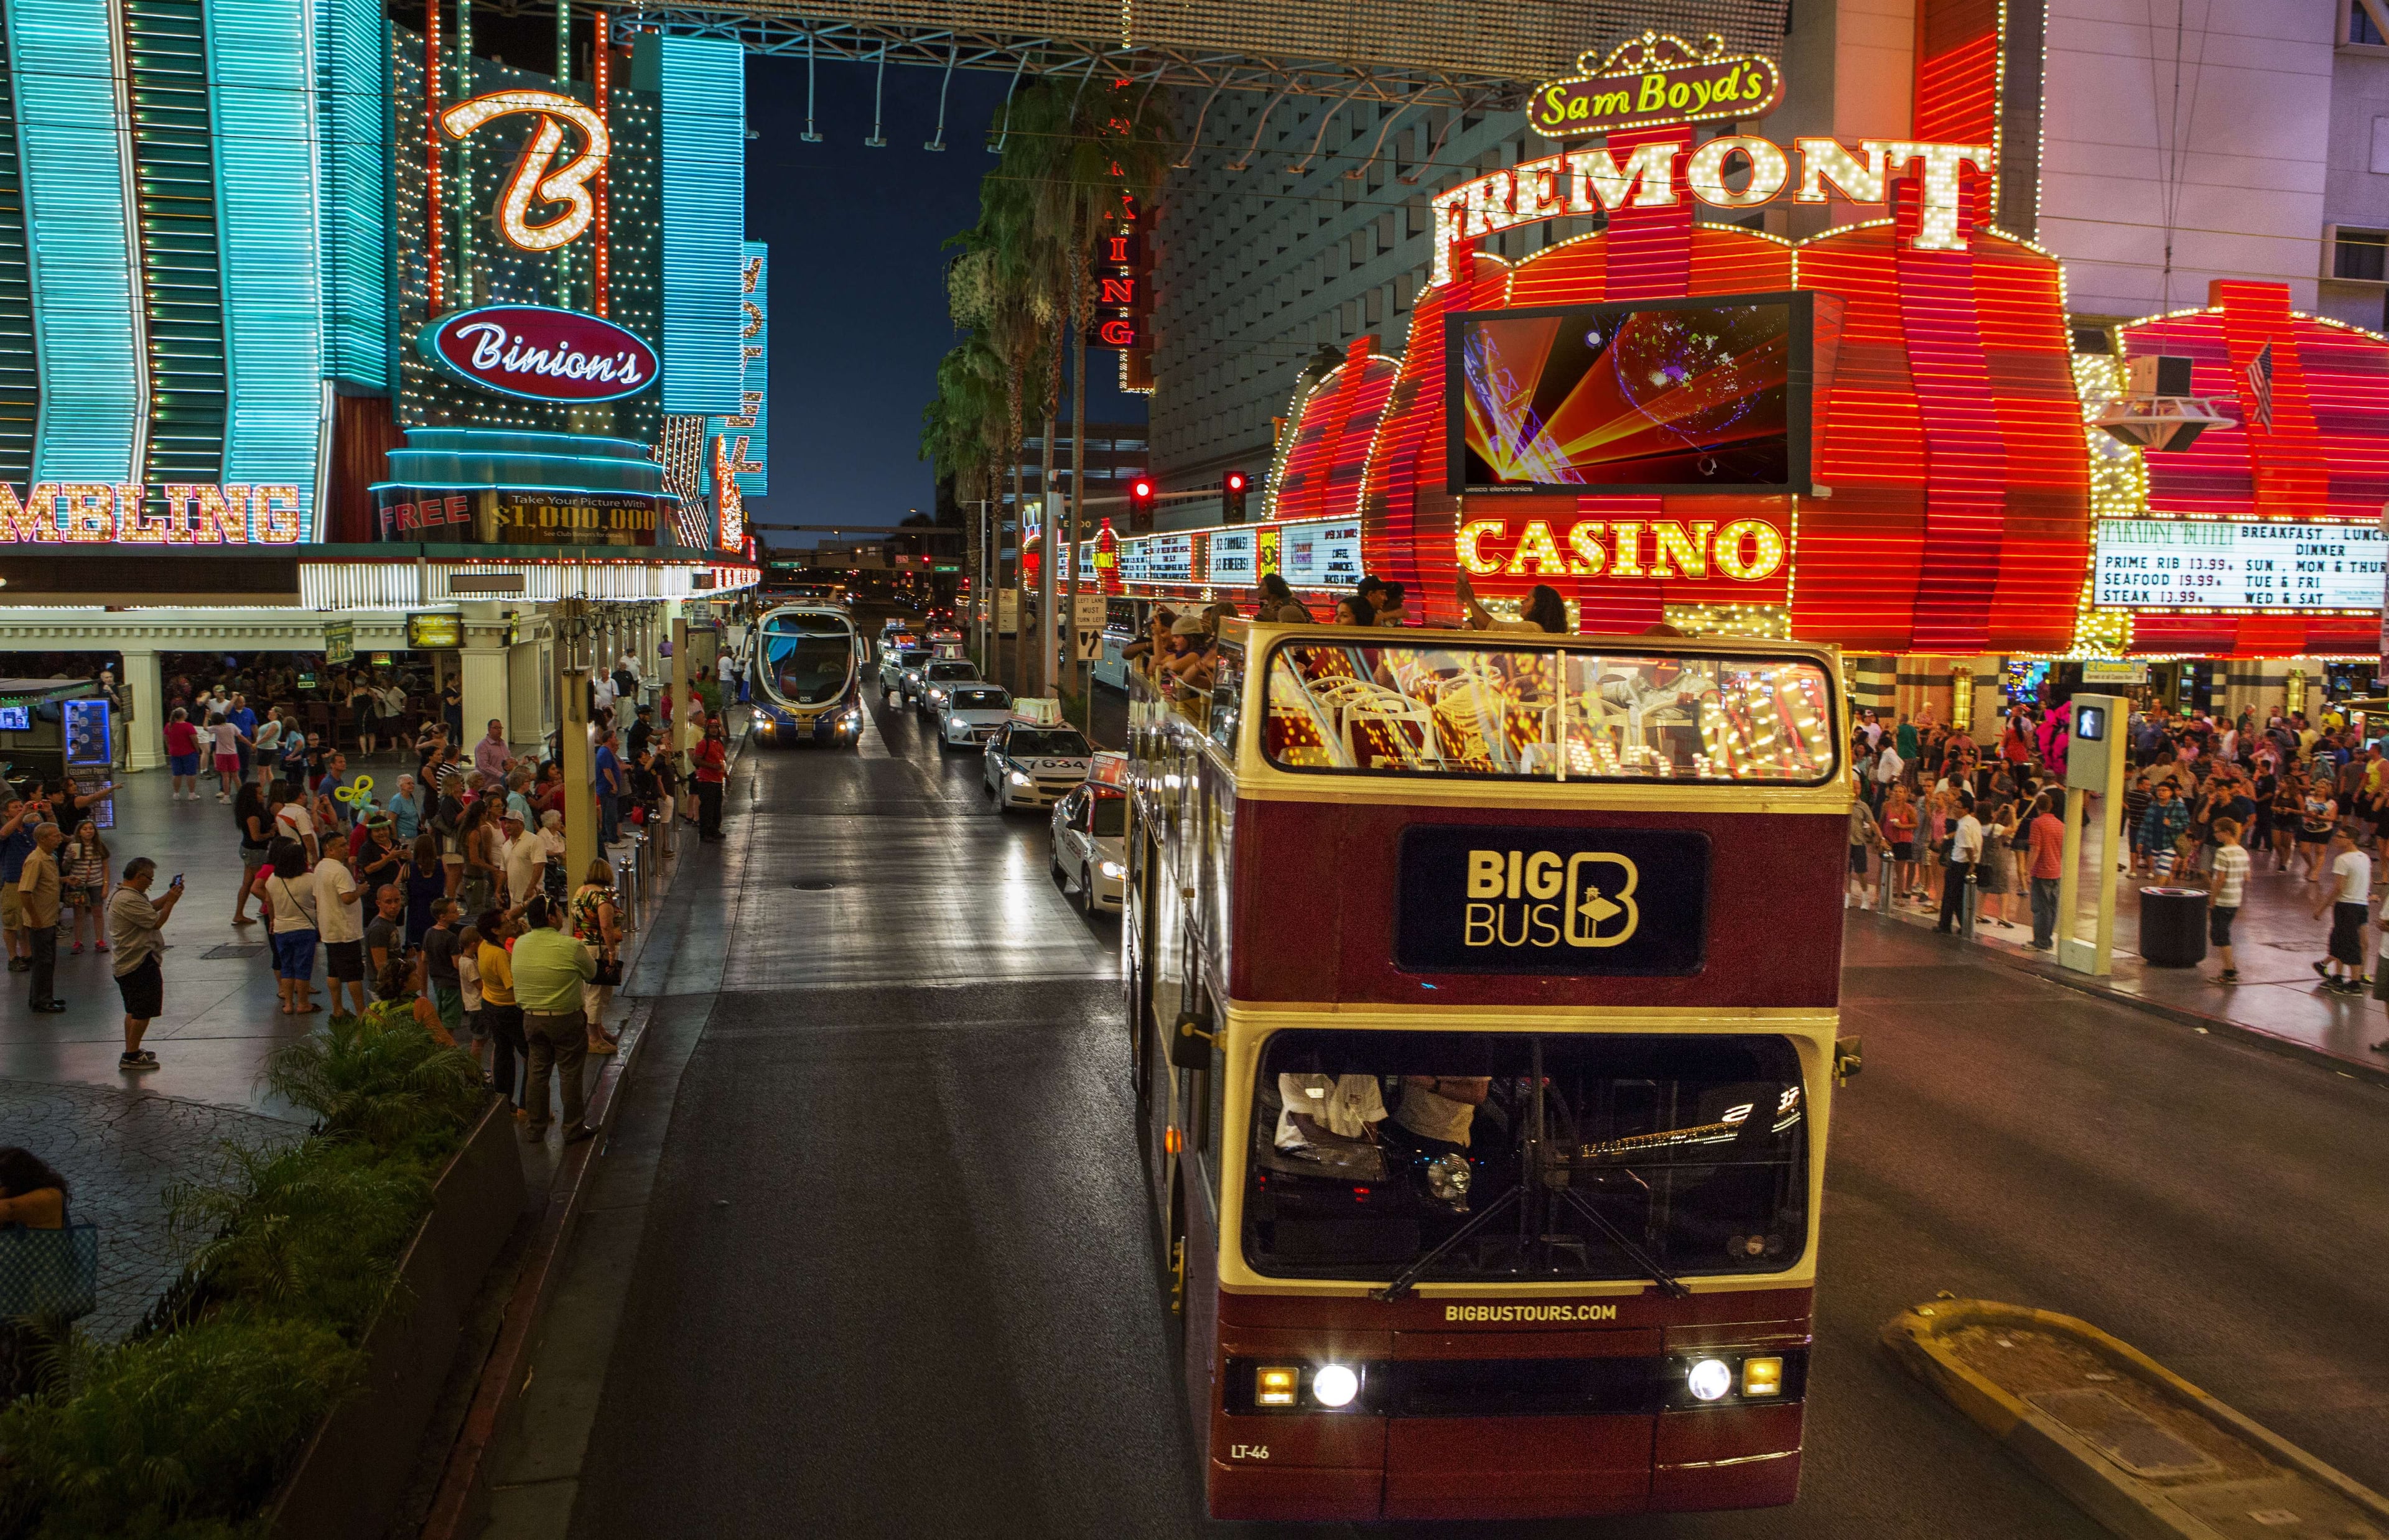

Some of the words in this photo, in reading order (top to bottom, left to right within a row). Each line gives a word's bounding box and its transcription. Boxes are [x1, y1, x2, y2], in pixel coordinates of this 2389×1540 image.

[1542, 85, 1629, 125] Sam
[1637, 61, 1763, 114] Boyd's
[440, 90, 610, 251] B
[1432, 136, 1993, 288] FREMONT
[456, 322, 642, 384] Binion's
[512, 494, 544, 504] Take
[547, 496, 577, 506] Your
[580, 497, 621, 507] Picture
[623, 499, 646, 509] With
[380, 495, 471, 534] FREE
[492, 504, 656, 531] $1,000,000
[2180, 522, 2236, 545] BUFFET
[2242, 526, 2322, 540] BREAKFAST
[1456, 518, 1785, 582] CASINO
[2296, 544, 2345, 557] DINNER
[2106, 557, 2148, 568] PRIME
[2158, 557, 2180, 569] RIB
[2246, 560, 2273, 572] SUN
[2296, 560, 2324, 572] MON
[2105, 573, 2169, 585] SEAFOOD
[2246, 575, 2271, 588] TUE
[2298, 577, 2321, 588] FRI
[2103, 590, 2150, 603] STEAK
[2245, 593, 2273, 605] WED
[2300, 593, 2324, 605] SAT
[1025, 760, 1087, 770] 7634
[1467, 850, 1563, 899] BIG
[1465, 903, 1560, 947] BUS
[1445, 1304, 1616, 1322] BIGBUSTOURS.COM
[1231, 1445, 1270, 1460] LT-46
